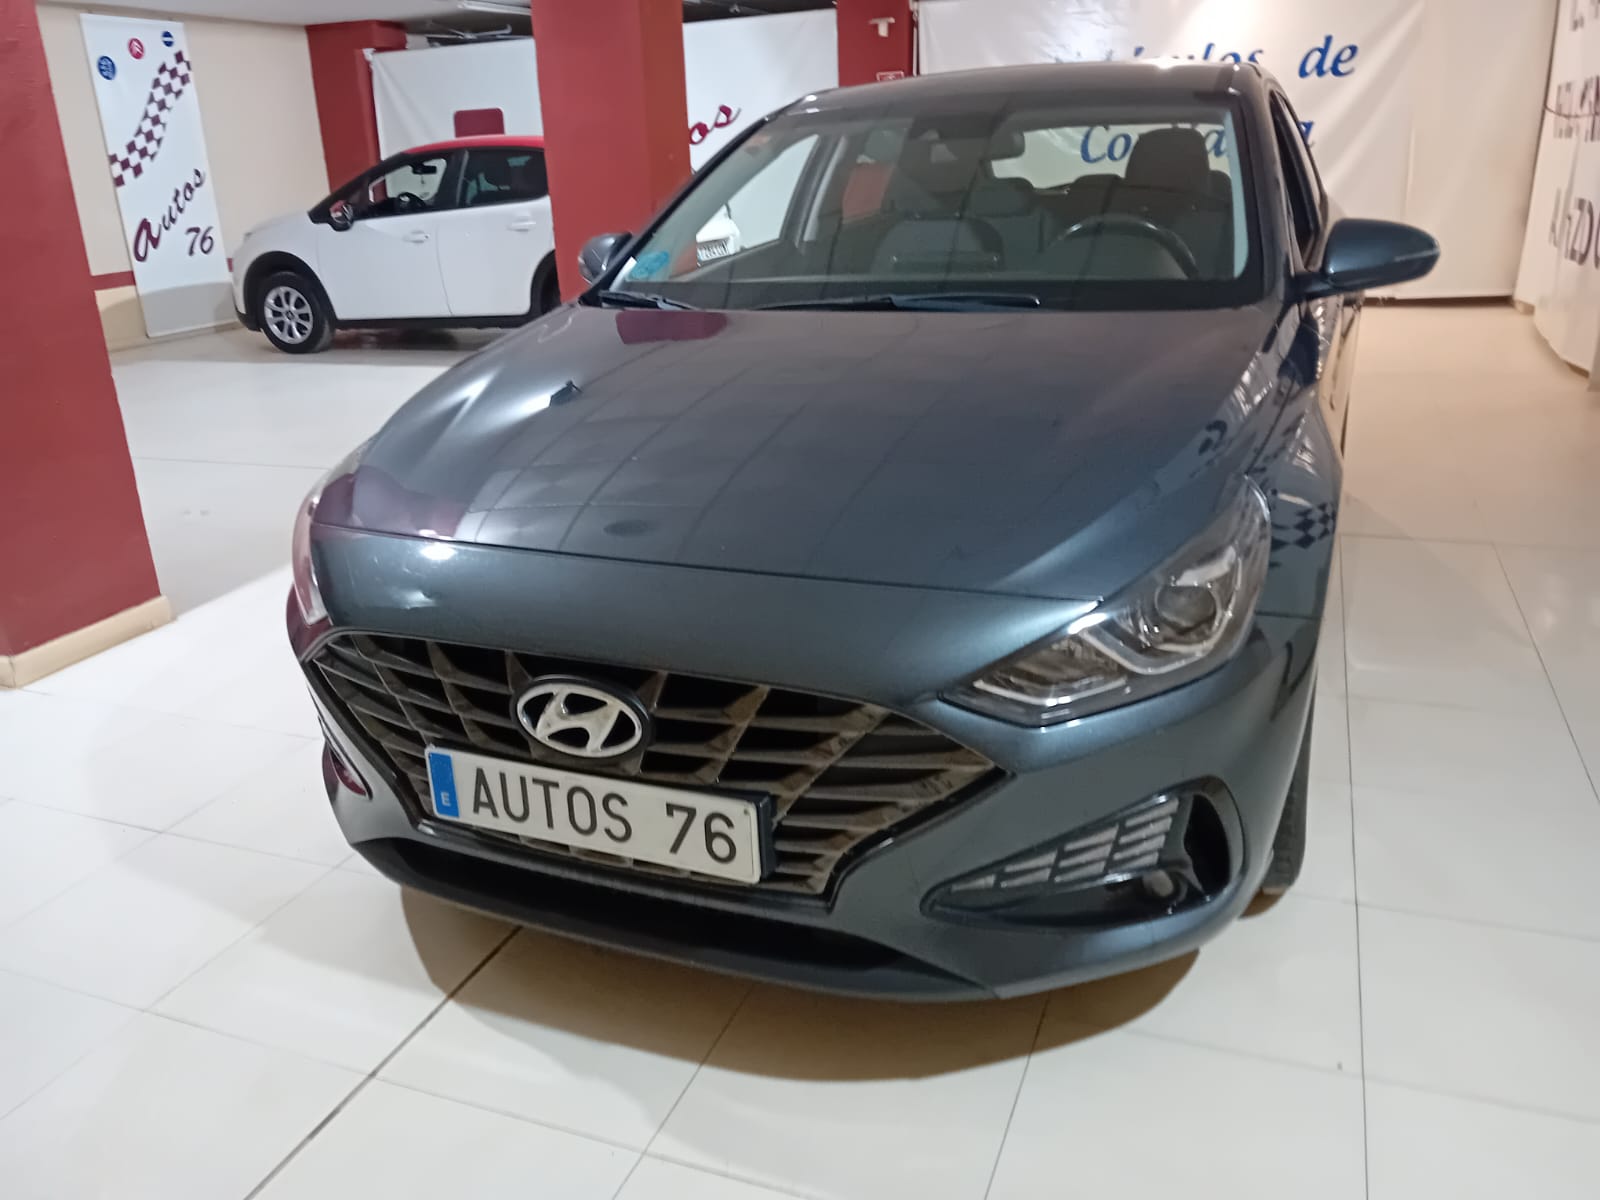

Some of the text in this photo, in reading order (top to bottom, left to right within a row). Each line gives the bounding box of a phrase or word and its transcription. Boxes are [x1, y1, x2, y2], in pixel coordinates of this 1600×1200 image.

[1298, 35, 1358, 79] de
[184, 226, 214, 257] 76
[472, 767, 737, 864] AUTOS 76
